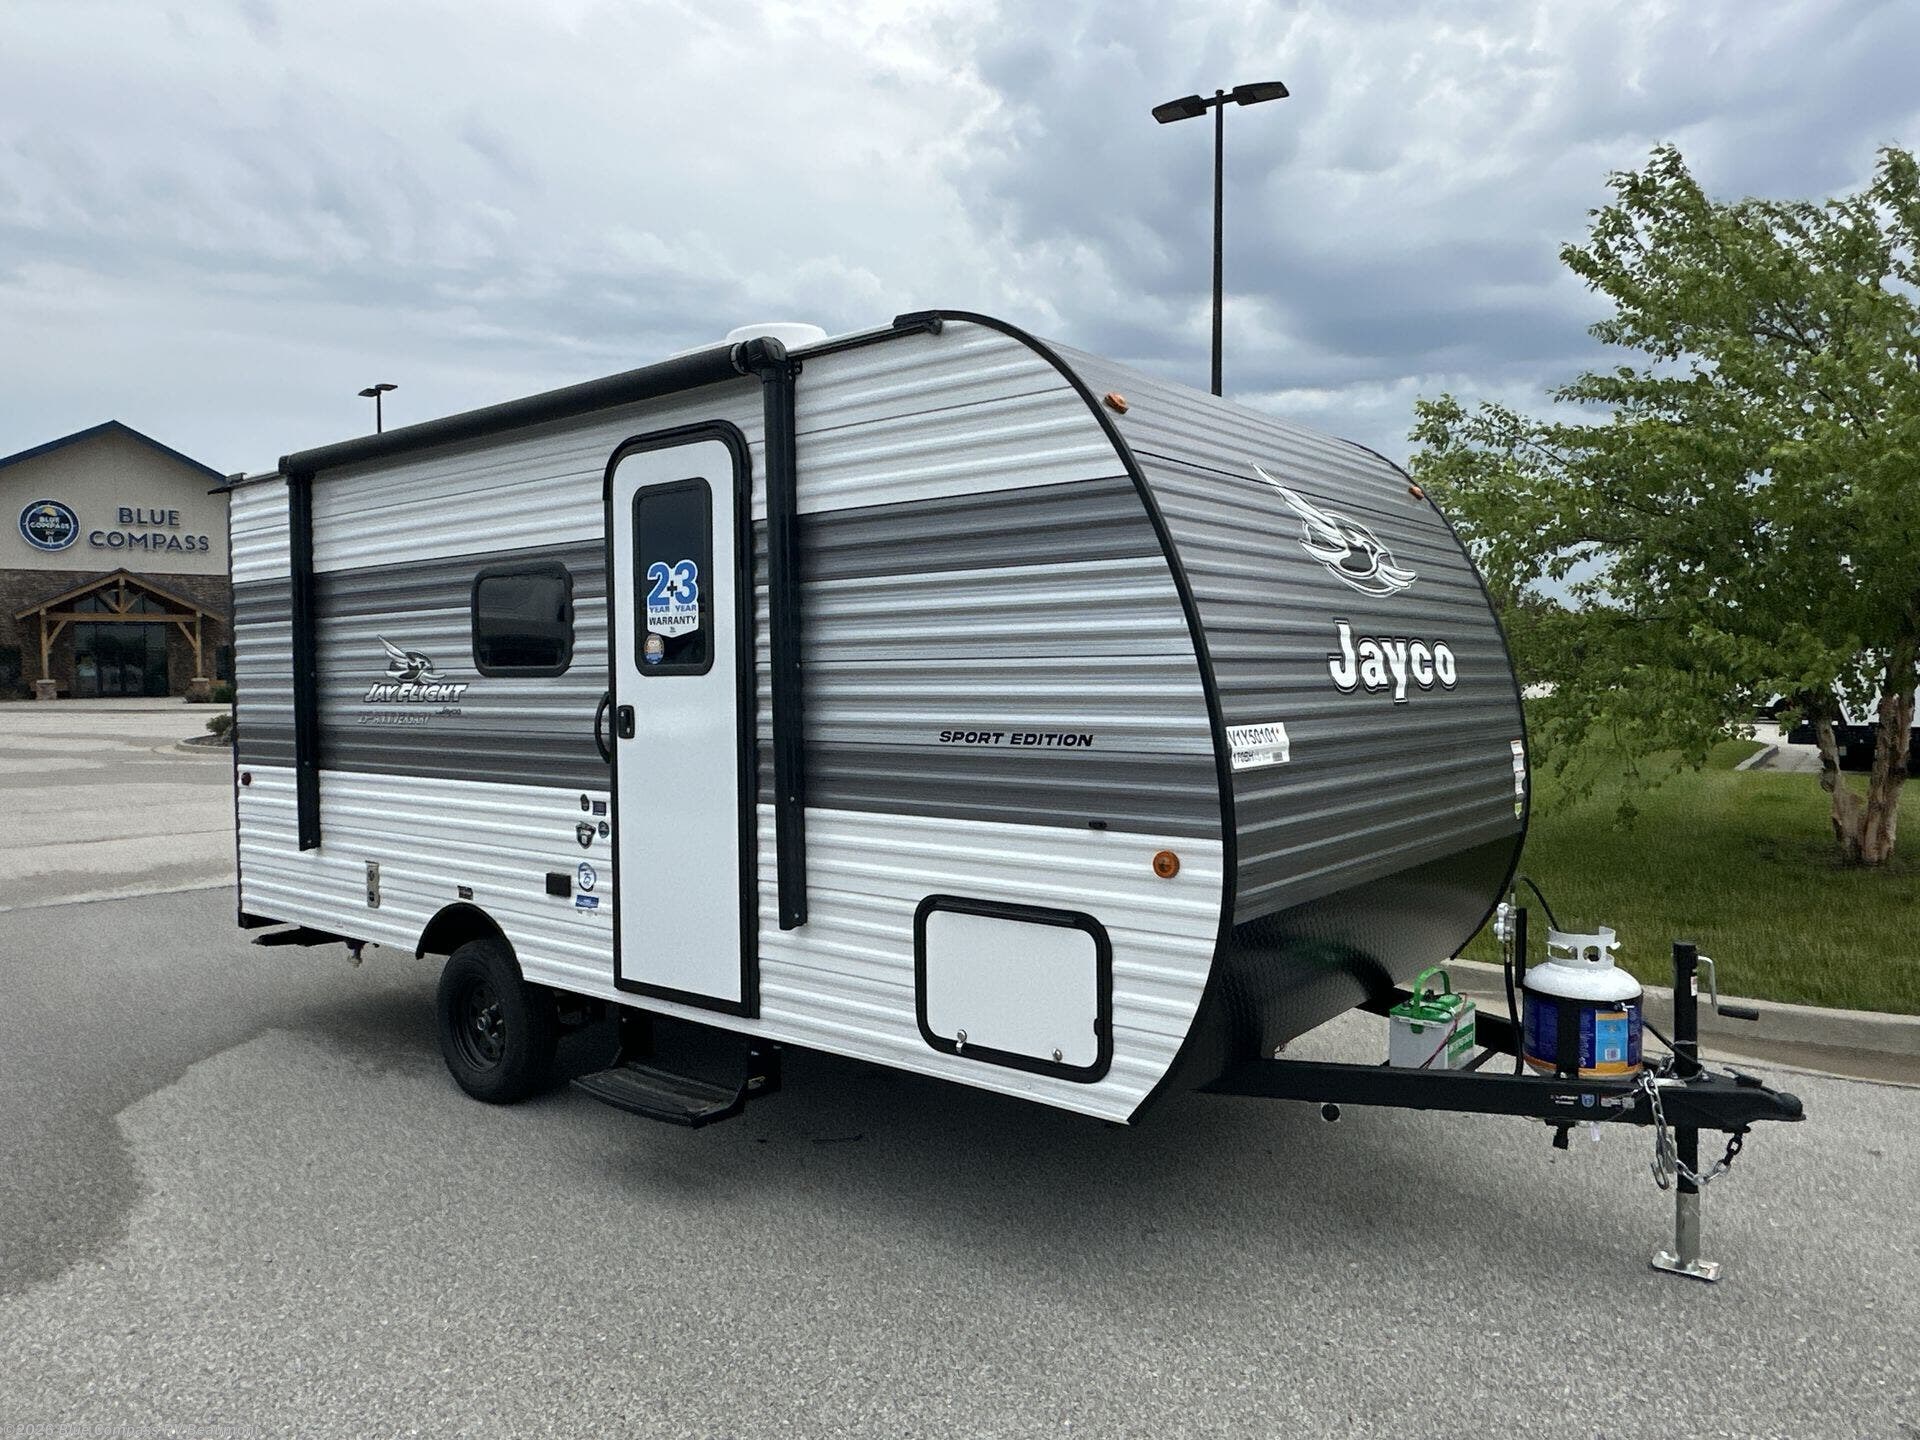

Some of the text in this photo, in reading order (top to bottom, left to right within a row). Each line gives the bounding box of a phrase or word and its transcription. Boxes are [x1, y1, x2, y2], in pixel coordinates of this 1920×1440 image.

[118, 507, 181, 526] BLUE
[89, 530, 210, 552] COMPASS
[649, 604, 697, 614] YEAR YEAR
[649, 615, 697, 626] WARRANTY
[1327, 617, 1458, 704] Jayco
[939, 730, 1094, 747] SPORT EDITION
